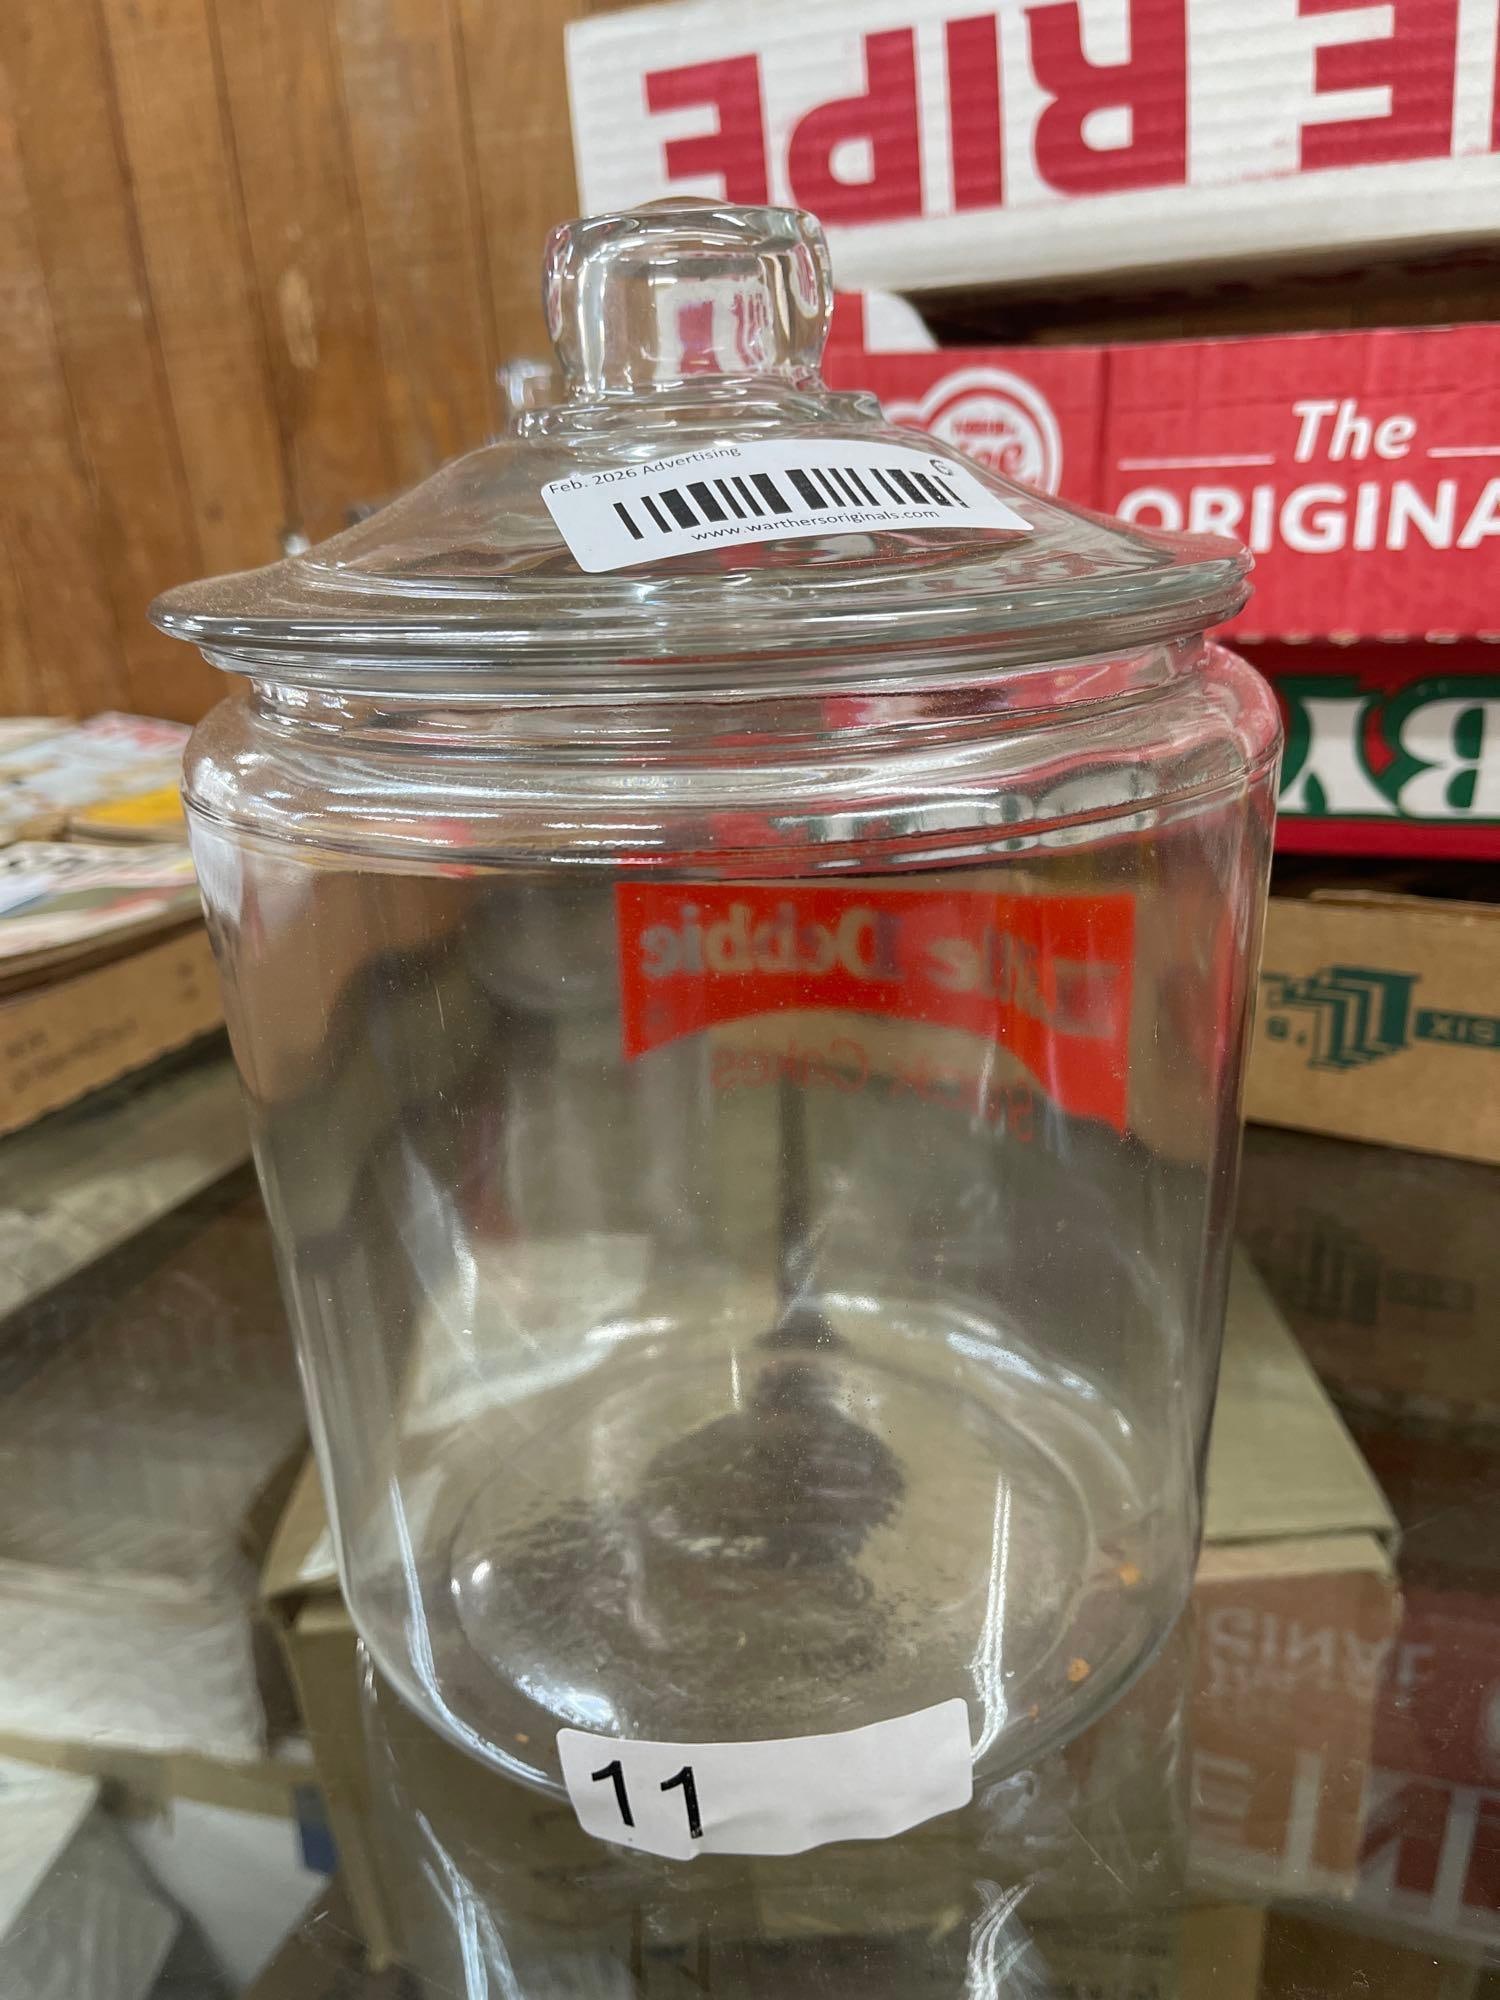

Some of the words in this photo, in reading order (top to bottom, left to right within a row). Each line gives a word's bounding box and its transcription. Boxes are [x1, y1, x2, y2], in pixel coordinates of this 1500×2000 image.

[644, 0, 1189, 226] RIPE
[1299, 0, 1500, 173] E
[1292, 397, 1417, 463] The
[550, 479, 588, 495] Feb.
[591, 468, 638, 485] 2026
[642, 446, 742, 474] Advertising
[691, 509, 940, 541] www.warthersoriginals.com
[591, 1760, 703, 1839] 11
